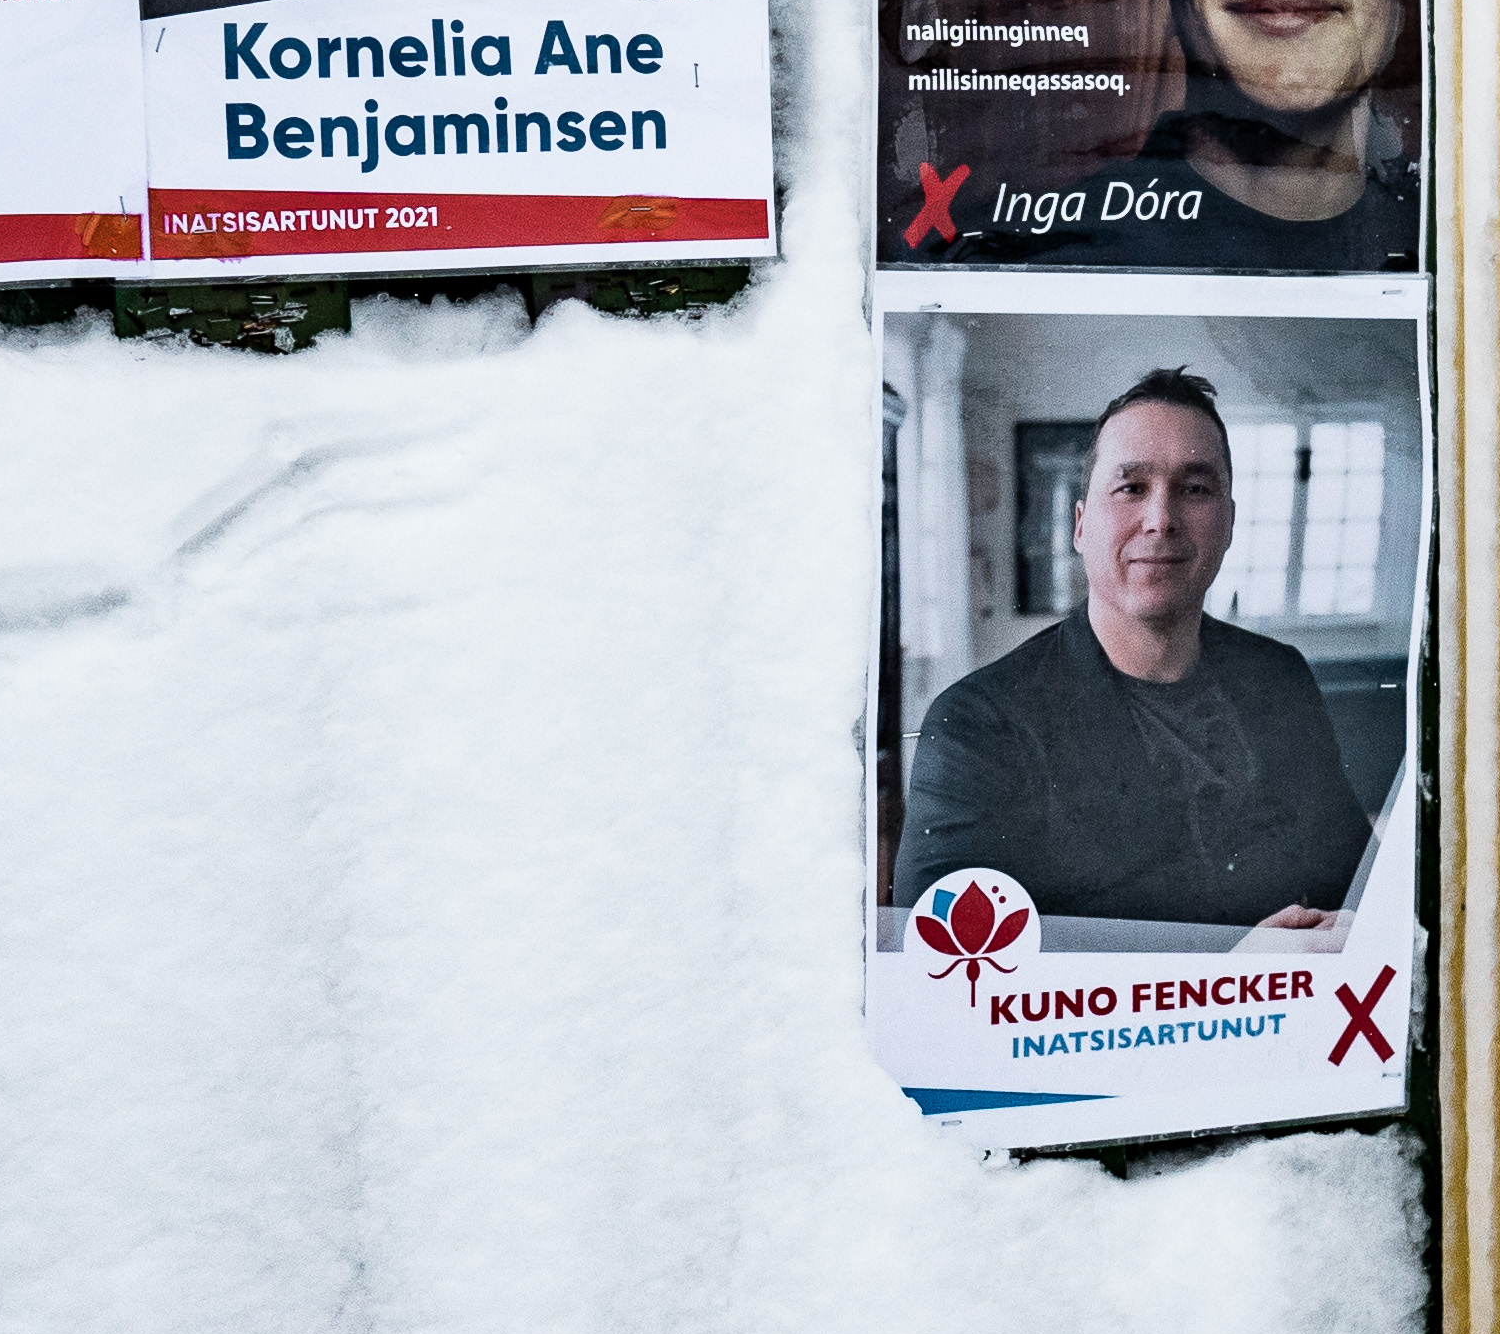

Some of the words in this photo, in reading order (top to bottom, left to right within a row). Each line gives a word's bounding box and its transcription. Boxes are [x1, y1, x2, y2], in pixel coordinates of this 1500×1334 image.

[223, 18, 512, 80] Kornelia
[535, 20, 664, 76] Ane
[906, 19, 1089, 48] naligiinnginneq
[908, 69, 1131, 97] millisinneqassasoq.
[225, 96, 668, 174] Benjaminsen
[163, 207, 378, 235] INATSISARTUNUT
[386, 207, 439, 228] 2021
[992, 183, 1087, 235] Inga
[1100, 178, 1202, 221] Dóra
[990, 985, 1118, 1025] KUNO
[1131, 970, 1314, 1014] FENCKER
[1011, 1013, 1287, 1058] INATSISARTUNUT
